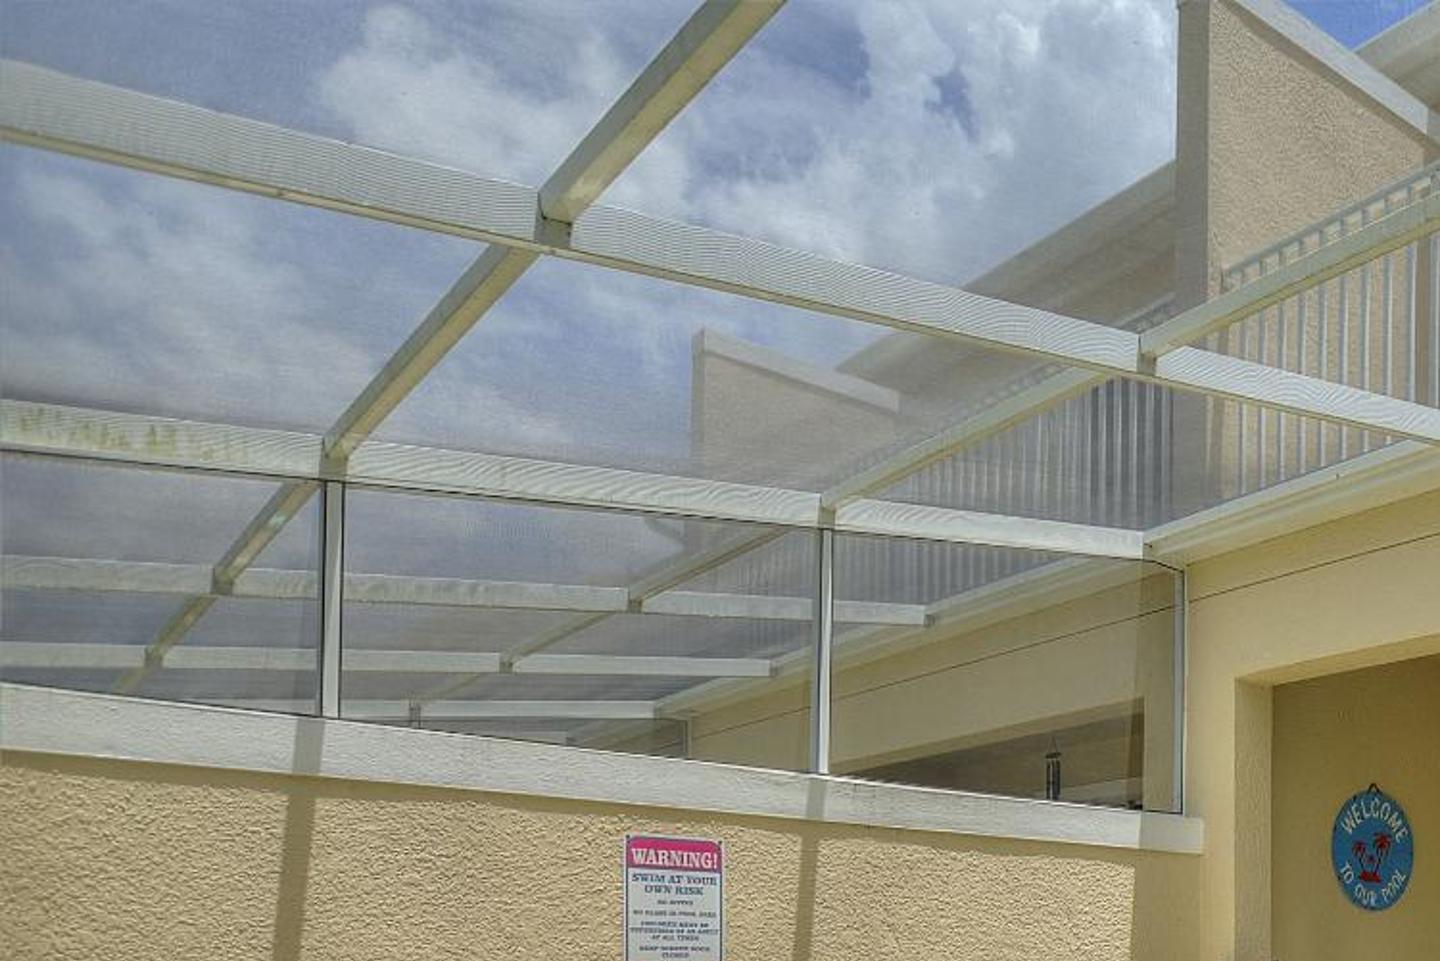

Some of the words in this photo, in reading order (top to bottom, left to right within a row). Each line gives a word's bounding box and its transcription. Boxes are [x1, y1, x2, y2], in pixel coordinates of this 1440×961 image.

[1342, 797, 1409, 843] WELCOME
[631, 848, 718, 869] WARNING!
[632, 873, 665, 883] SWIM
[667, 875, 683, 884] AT
[686, 876, 717, 885] YOUR
[644, 884, 672, 894] OWN
[675, 886, 704, 895] RISK
[1340, 862, 1354, 885] TO
[1354, 884, 1377, 906] OUR
[1381, 869, 1407, 902] POOL
